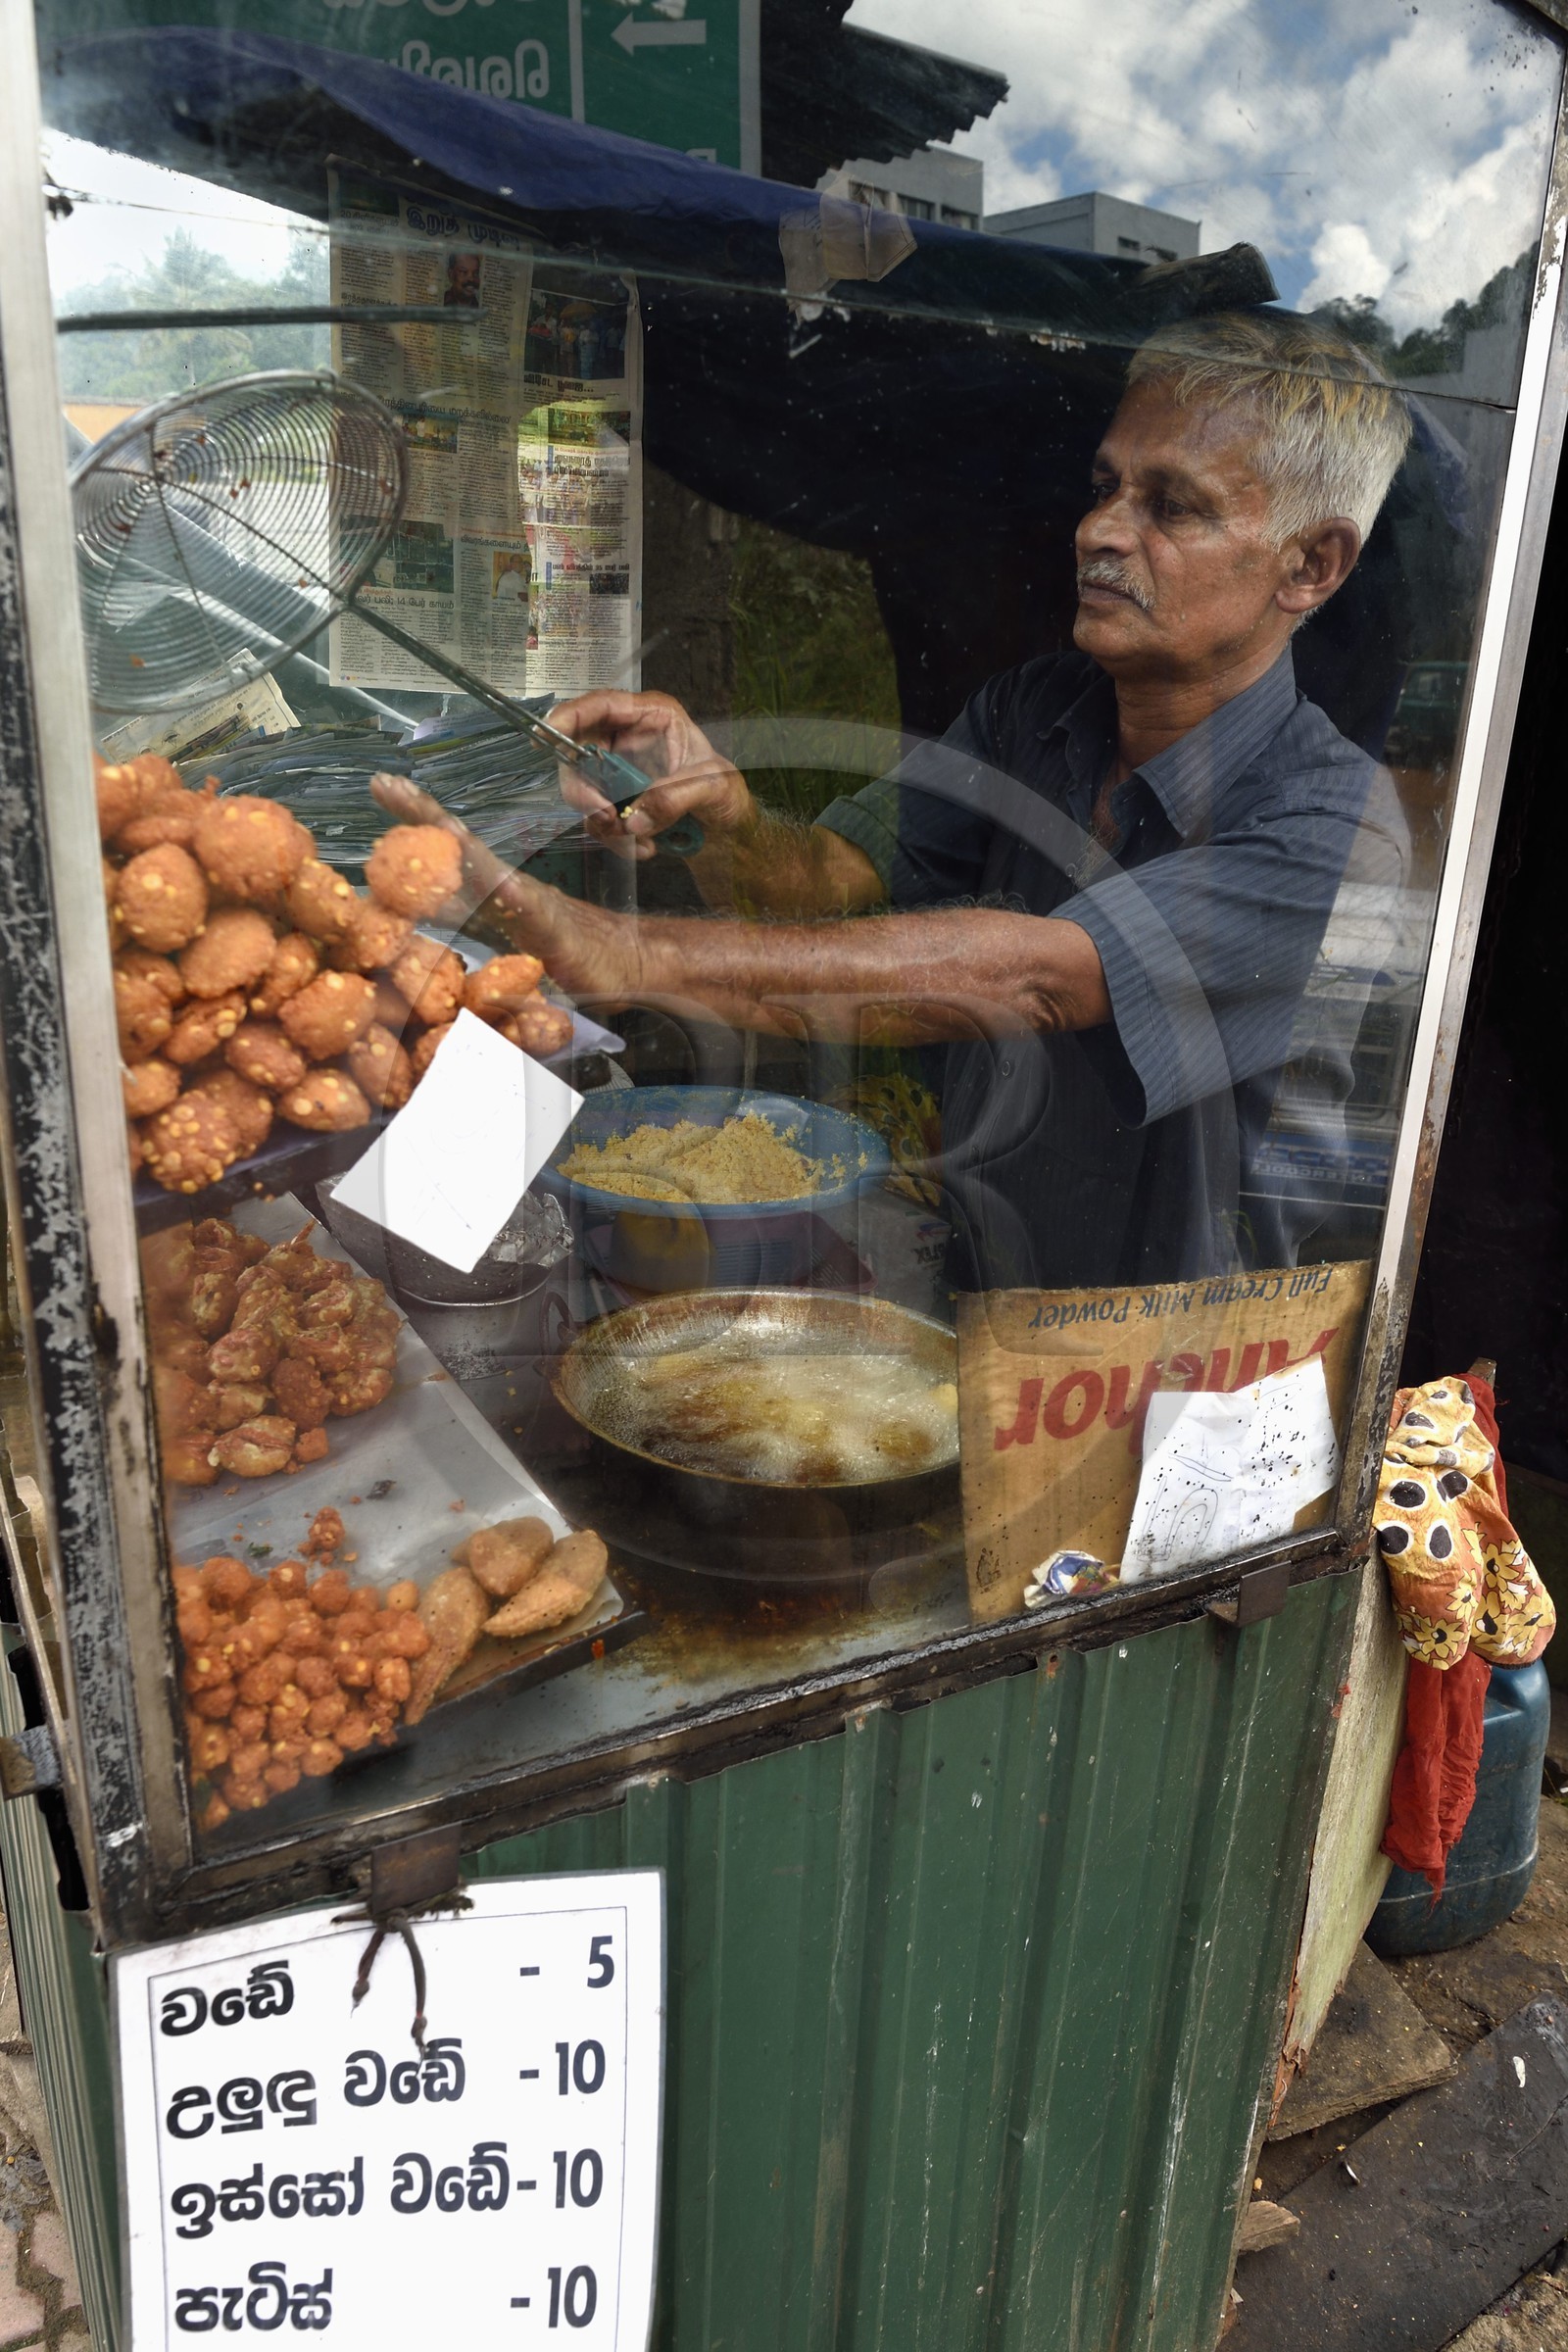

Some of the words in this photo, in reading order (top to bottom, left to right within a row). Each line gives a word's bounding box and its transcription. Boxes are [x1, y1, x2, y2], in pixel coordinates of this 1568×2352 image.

[1201, 1276, 1283, 1306] Cream
[1289, 1268, 1334, 1299] Full
[1028, 1296, 1132, 1330] Powder
[1140, 1287, 1195, 1318] Milk
[160, 1960, 295, 2037] වඩේ
[587, 1936, 615, 1989] 5
[166, 2070, 318, 2139] උලුඳු
[343, 2037, 466, 2107] වඩේ
[390, 2141, 510, 2215] වඩේ
